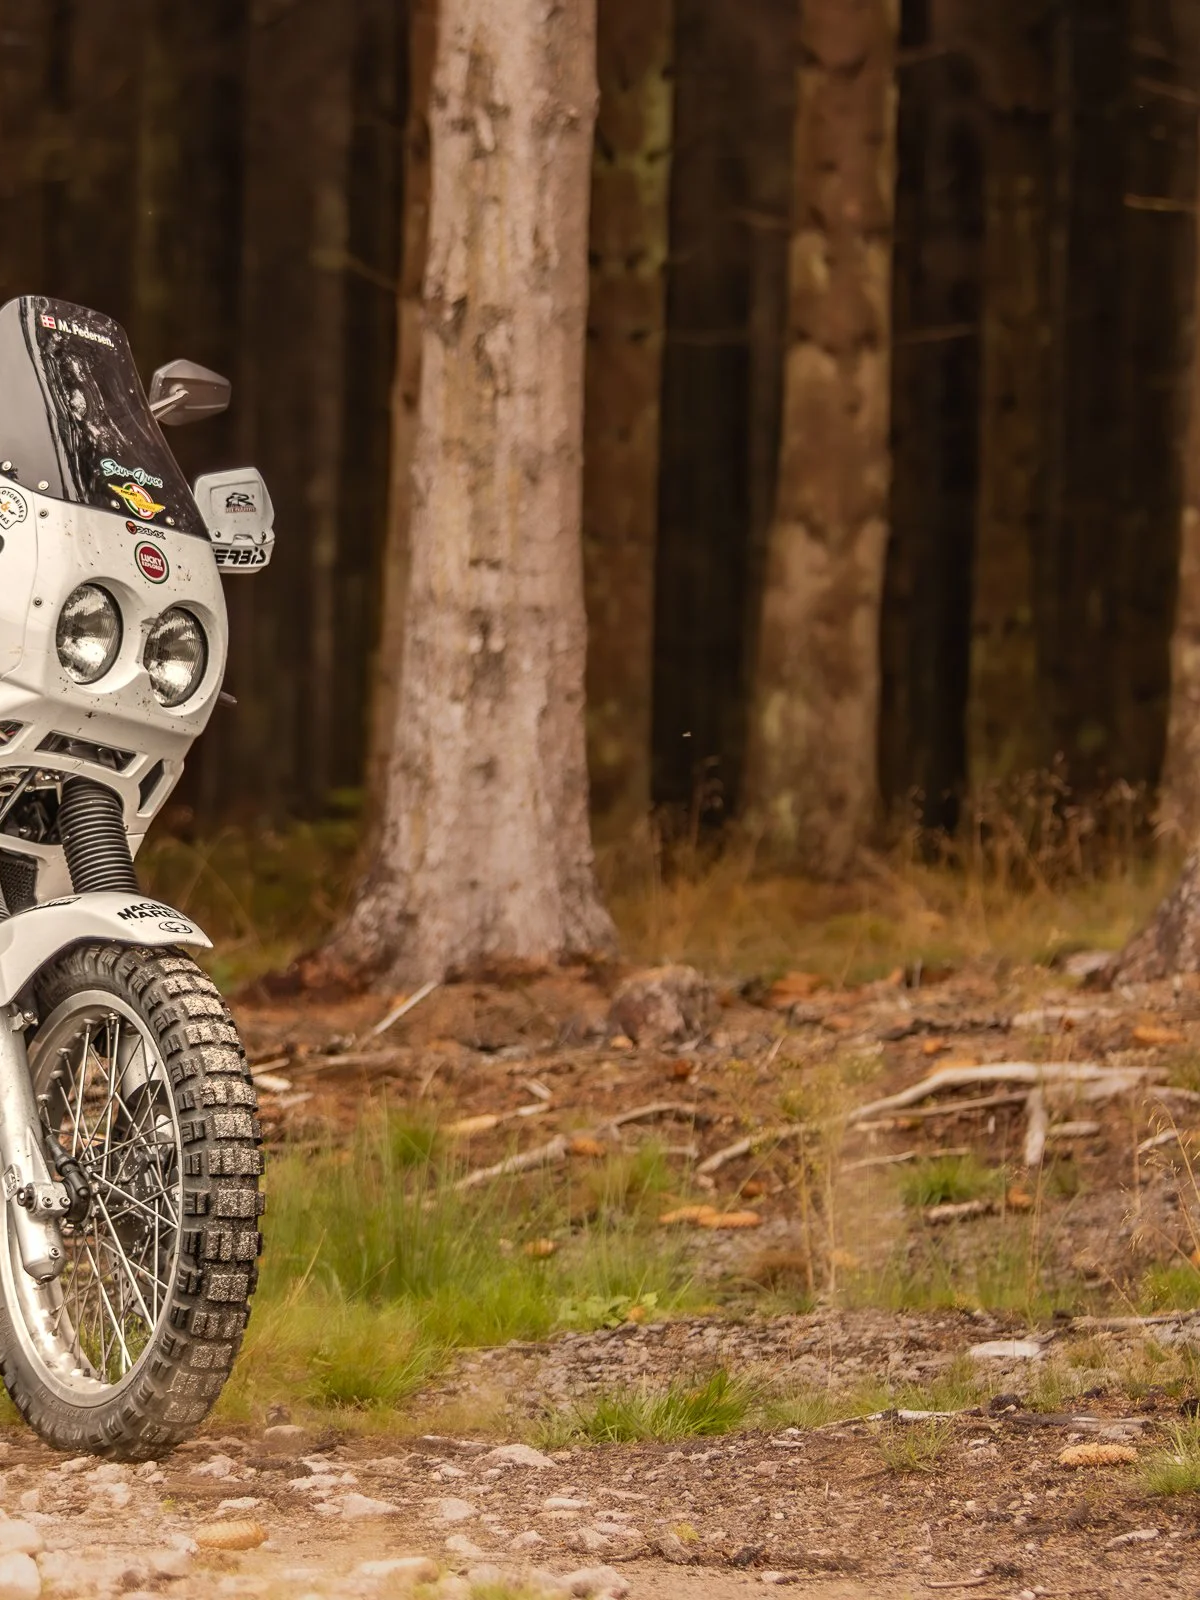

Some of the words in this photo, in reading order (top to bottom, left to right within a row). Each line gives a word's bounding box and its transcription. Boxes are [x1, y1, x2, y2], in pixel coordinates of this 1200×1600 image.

[57, 318, 72, 334] M.
[140, 552, 163, 568] LUCKY
[212, 546, 267, 565] ERBIS
